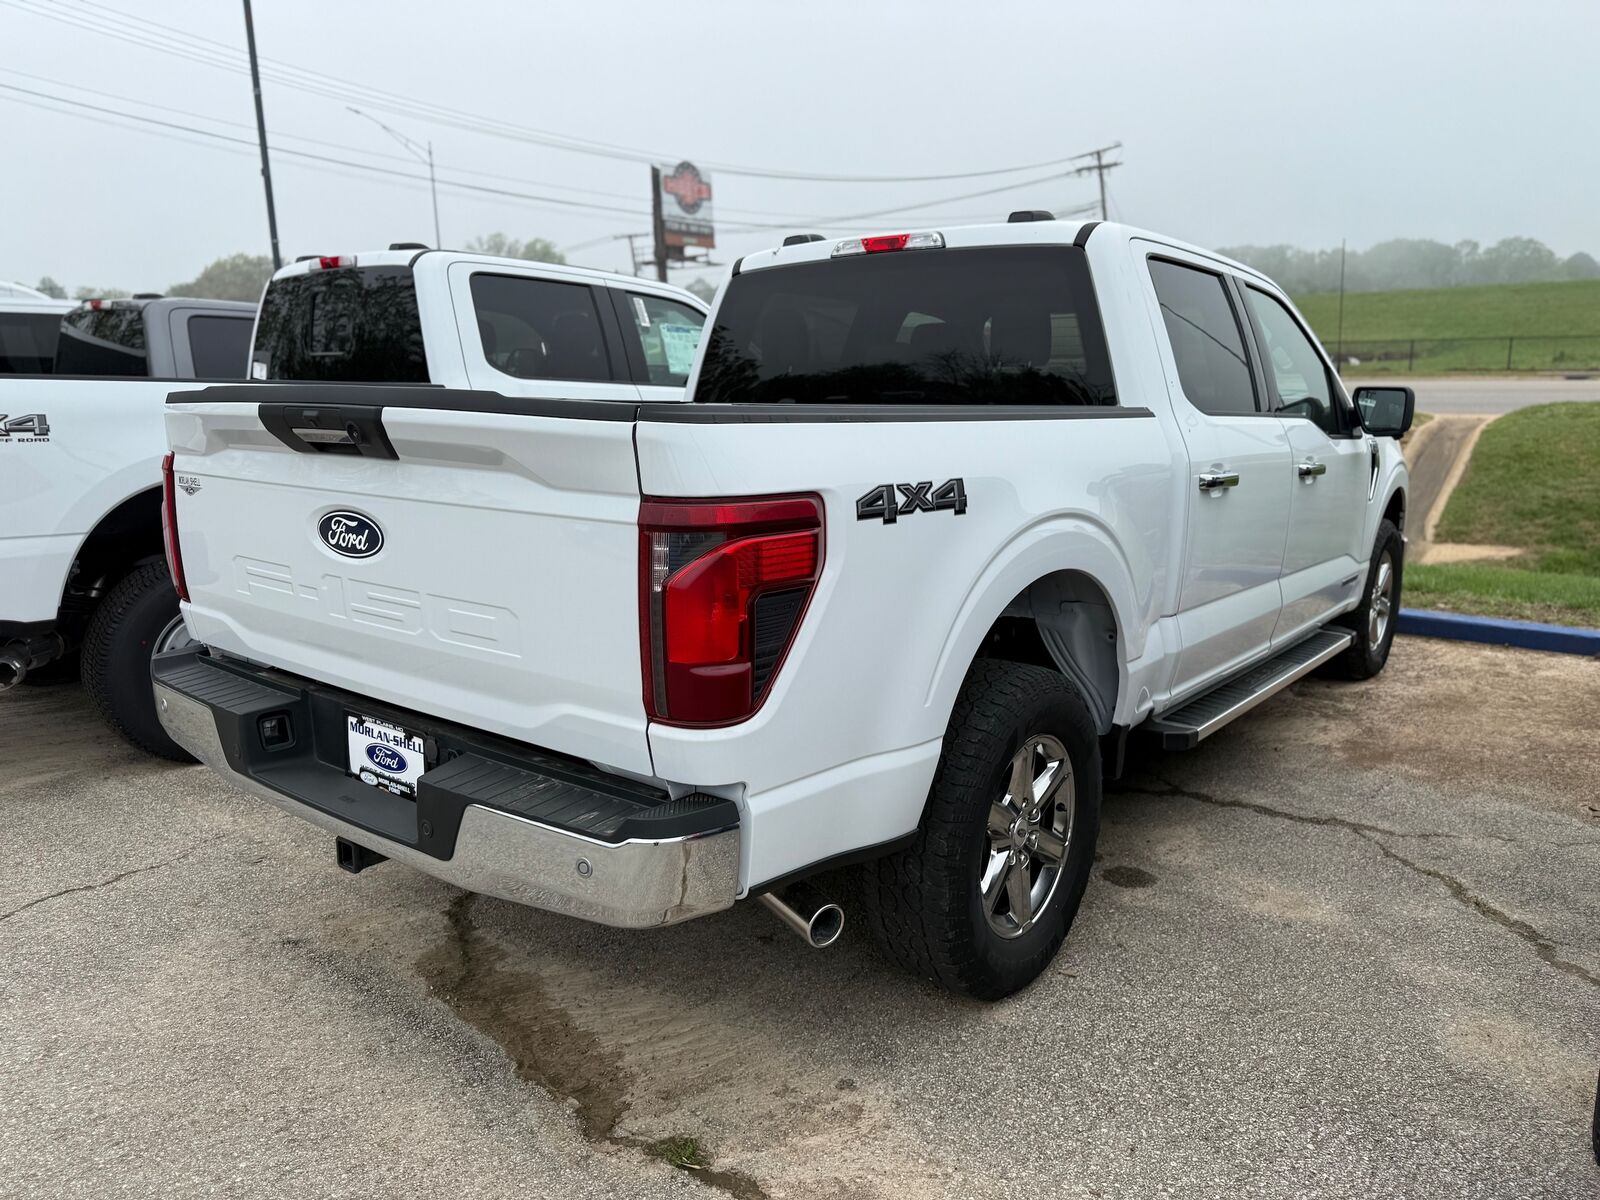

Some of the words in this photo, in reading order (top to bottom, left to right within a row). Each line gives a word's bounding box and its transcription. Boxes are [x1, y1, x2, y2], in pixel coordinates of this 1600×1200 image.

[0, 414, 50, 436] 4
[327, 516, 369, 551] Ford
[233, 554, 522, 659] F-150
[350, 721, 424, 754] MORLAN-SHELL
[373, 746, 399, 769] Ford
